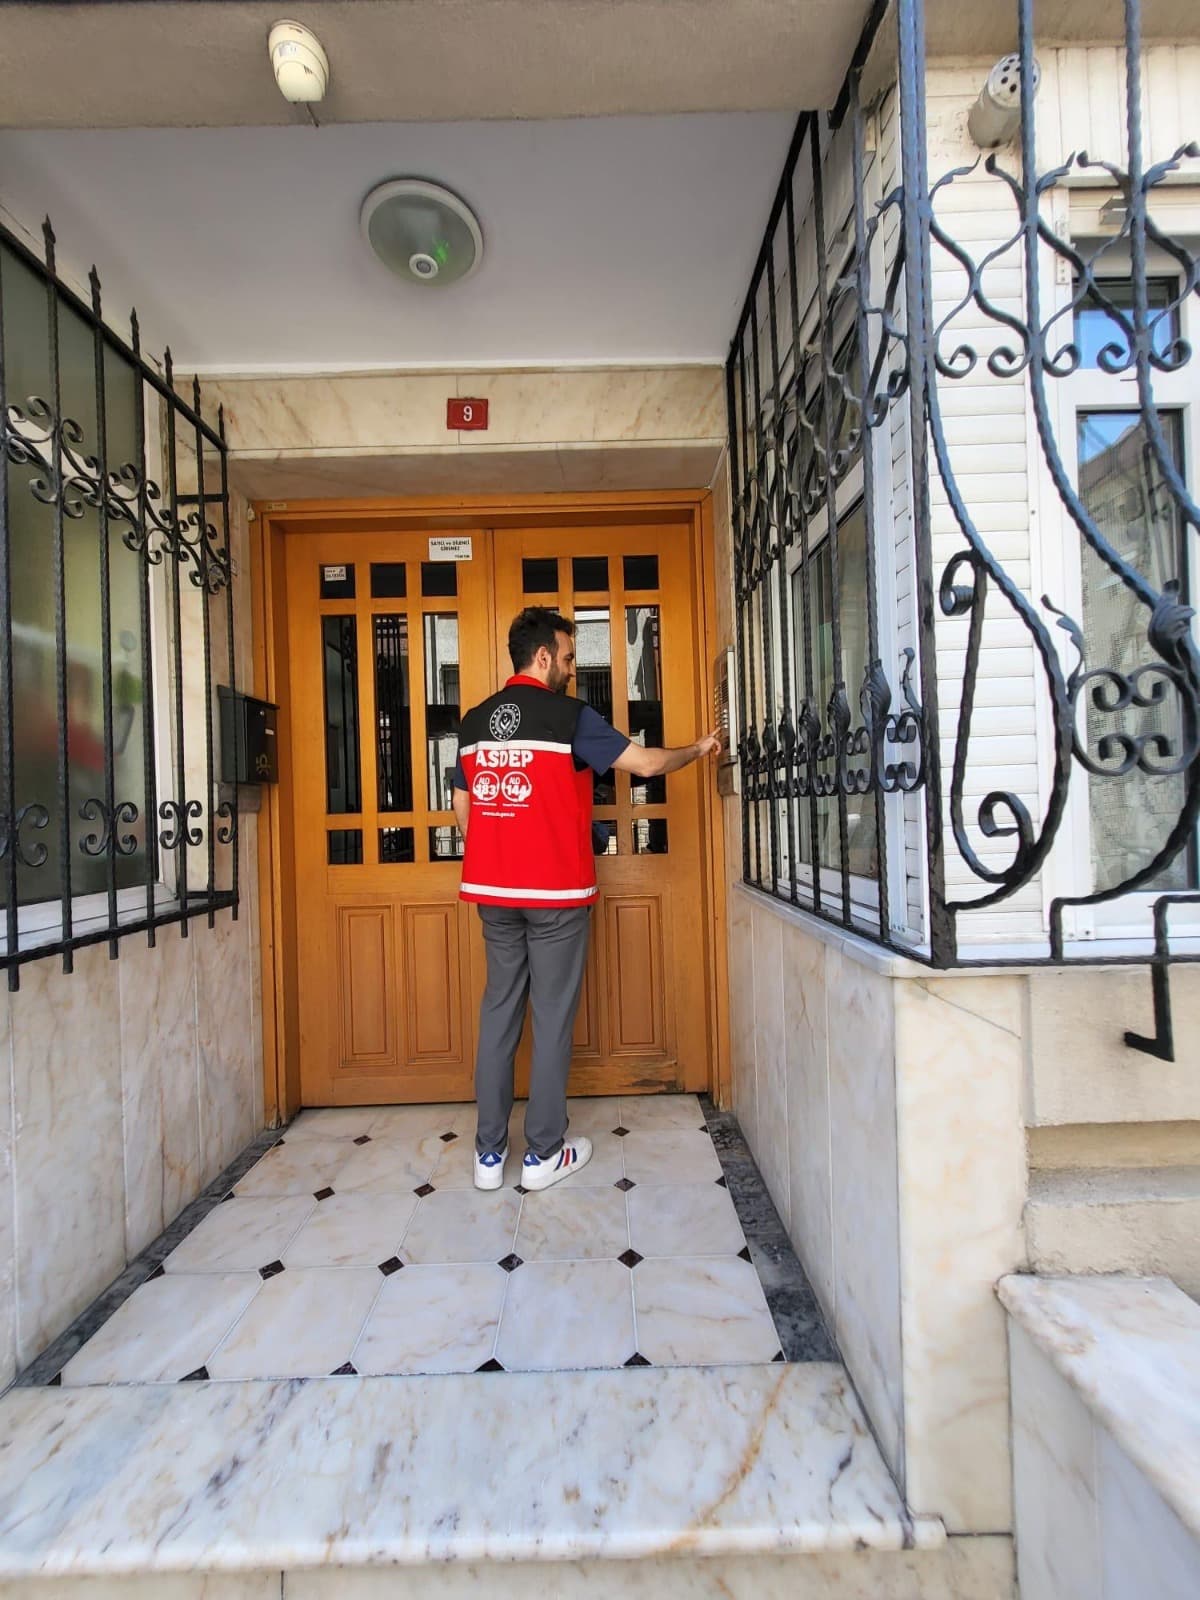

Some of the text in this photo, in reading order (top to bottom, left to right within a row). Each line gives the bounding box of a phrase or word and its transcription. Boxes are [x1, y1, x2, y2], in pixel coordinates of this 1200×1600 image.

[463, 405, 473, 422] 9
[476, 750, 533, 768] ASDEP
[475, 784, 497, 795] 183
[505, 784, 527, 796] 144
